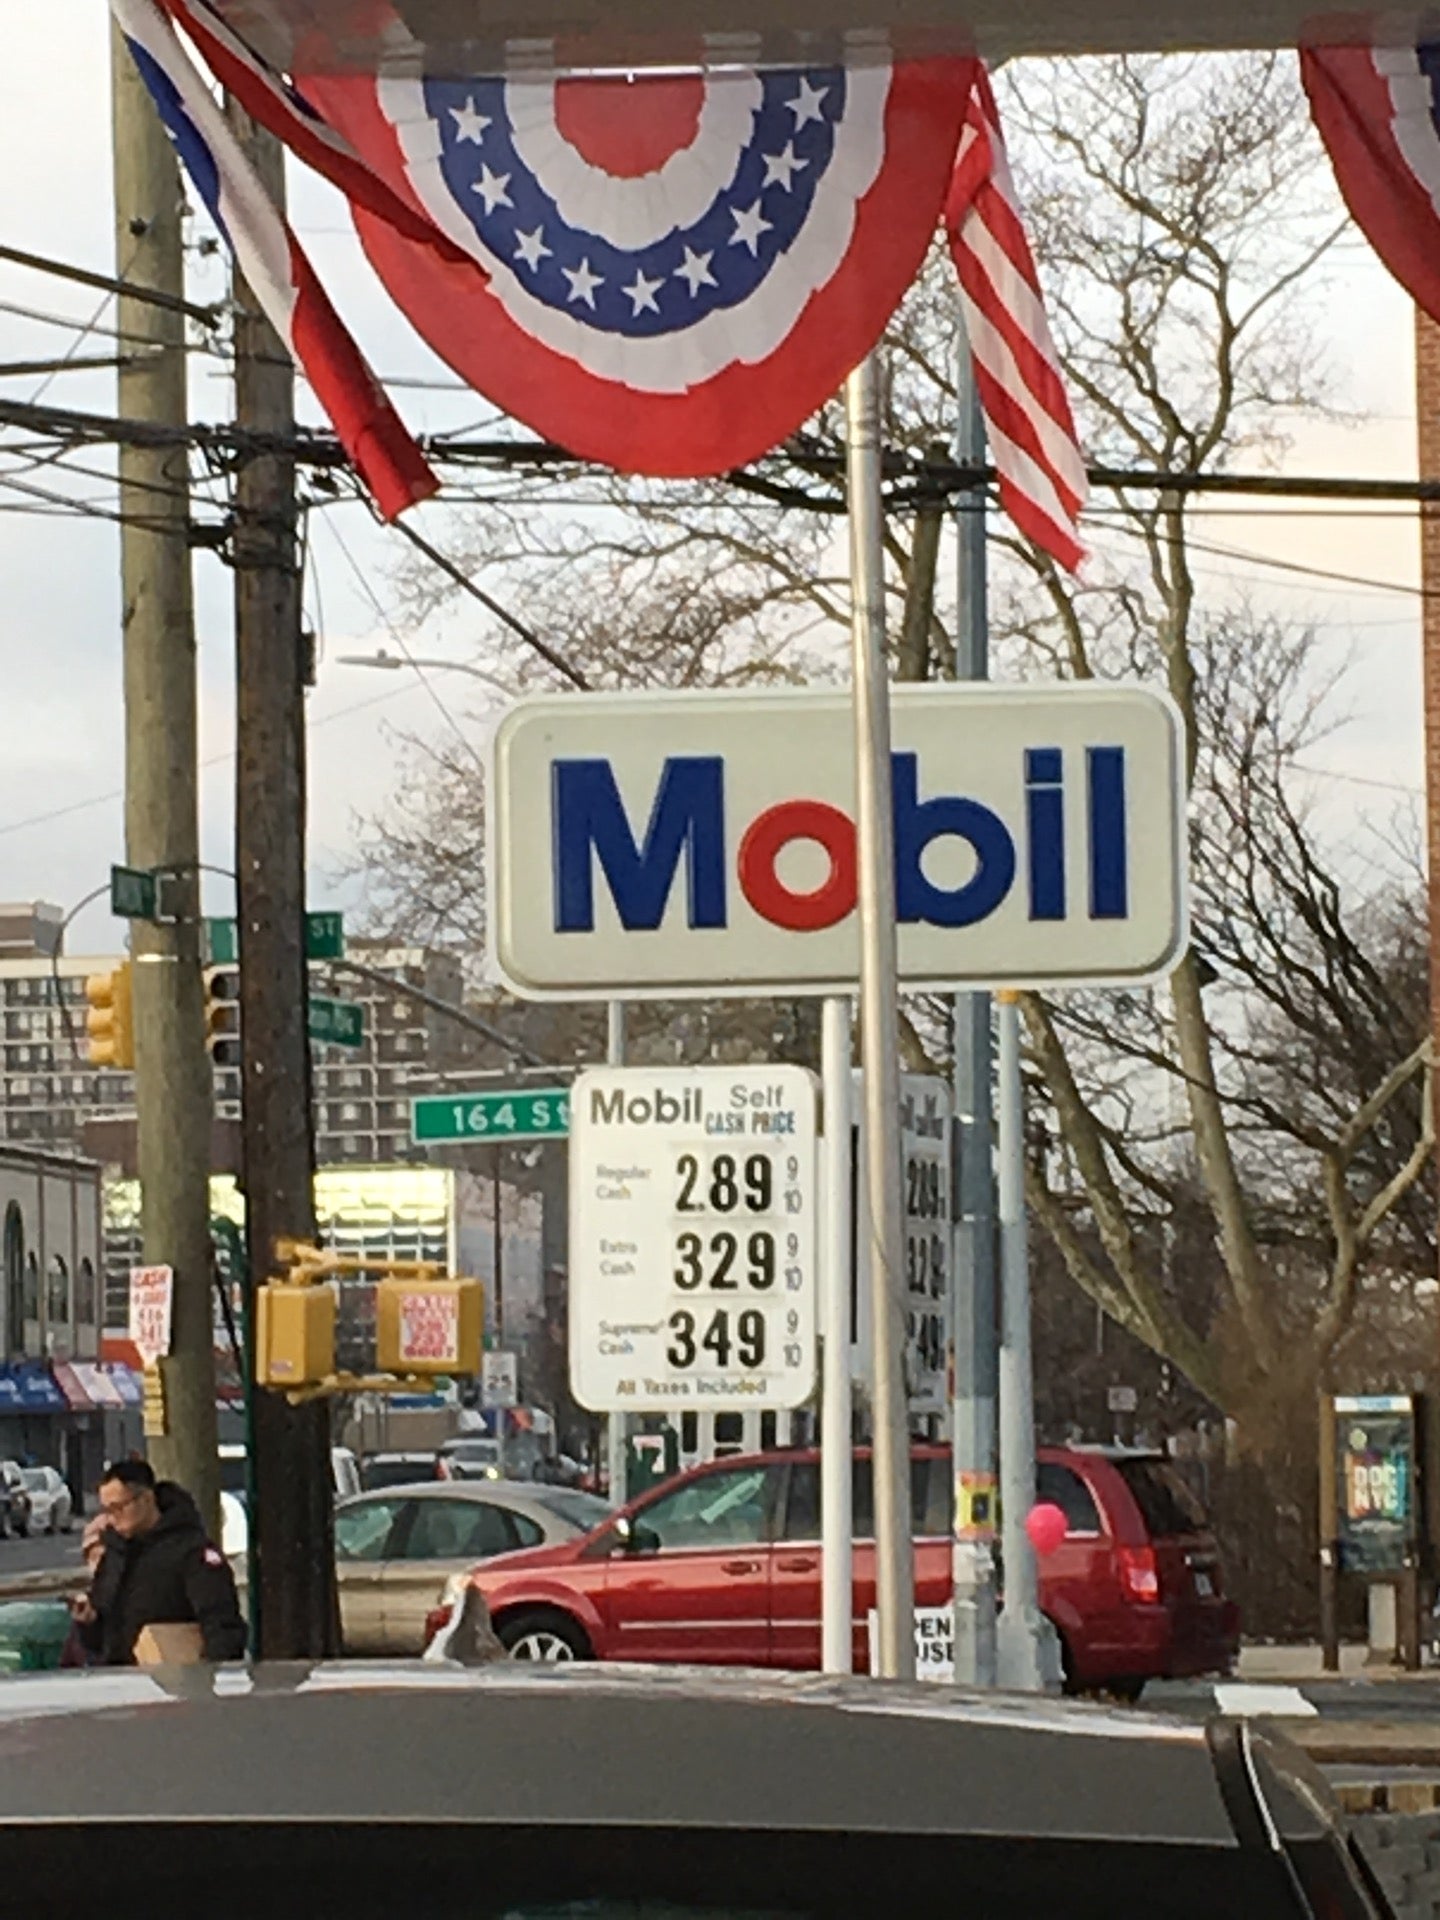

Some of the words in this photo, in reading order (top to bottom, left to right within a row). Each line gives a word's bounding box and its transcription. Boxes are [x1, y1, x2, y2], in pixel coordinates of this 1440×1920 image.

[551, 745, 1129, 933] Mobil
[590, 1087, 703, 1124] Mobil
[729, 1084, 784, 1108] Self
[452, 1102, 517, 1133] 164
[531, 1099, 570, 1128] St
[705, 1111, 745, 1135] CASH
[751, 1111, 795, 1135] PRICE
[596, 1164, 651, 1183] Regular
[786, 1155, 799, 1181] 9
[599, 1239, 638, 1254] Extra
[786, 1232, 799, 1258] 9
[673, 1230, 776, 1291] 329
[786, 1308, 799, 1334] 9
[666, 1308, 766, 1370] 349
[616, 1379, 636, 1395] All
[642, 1379, 690, 1395] Taxes
[697, 1378, 767, 1395] Included
